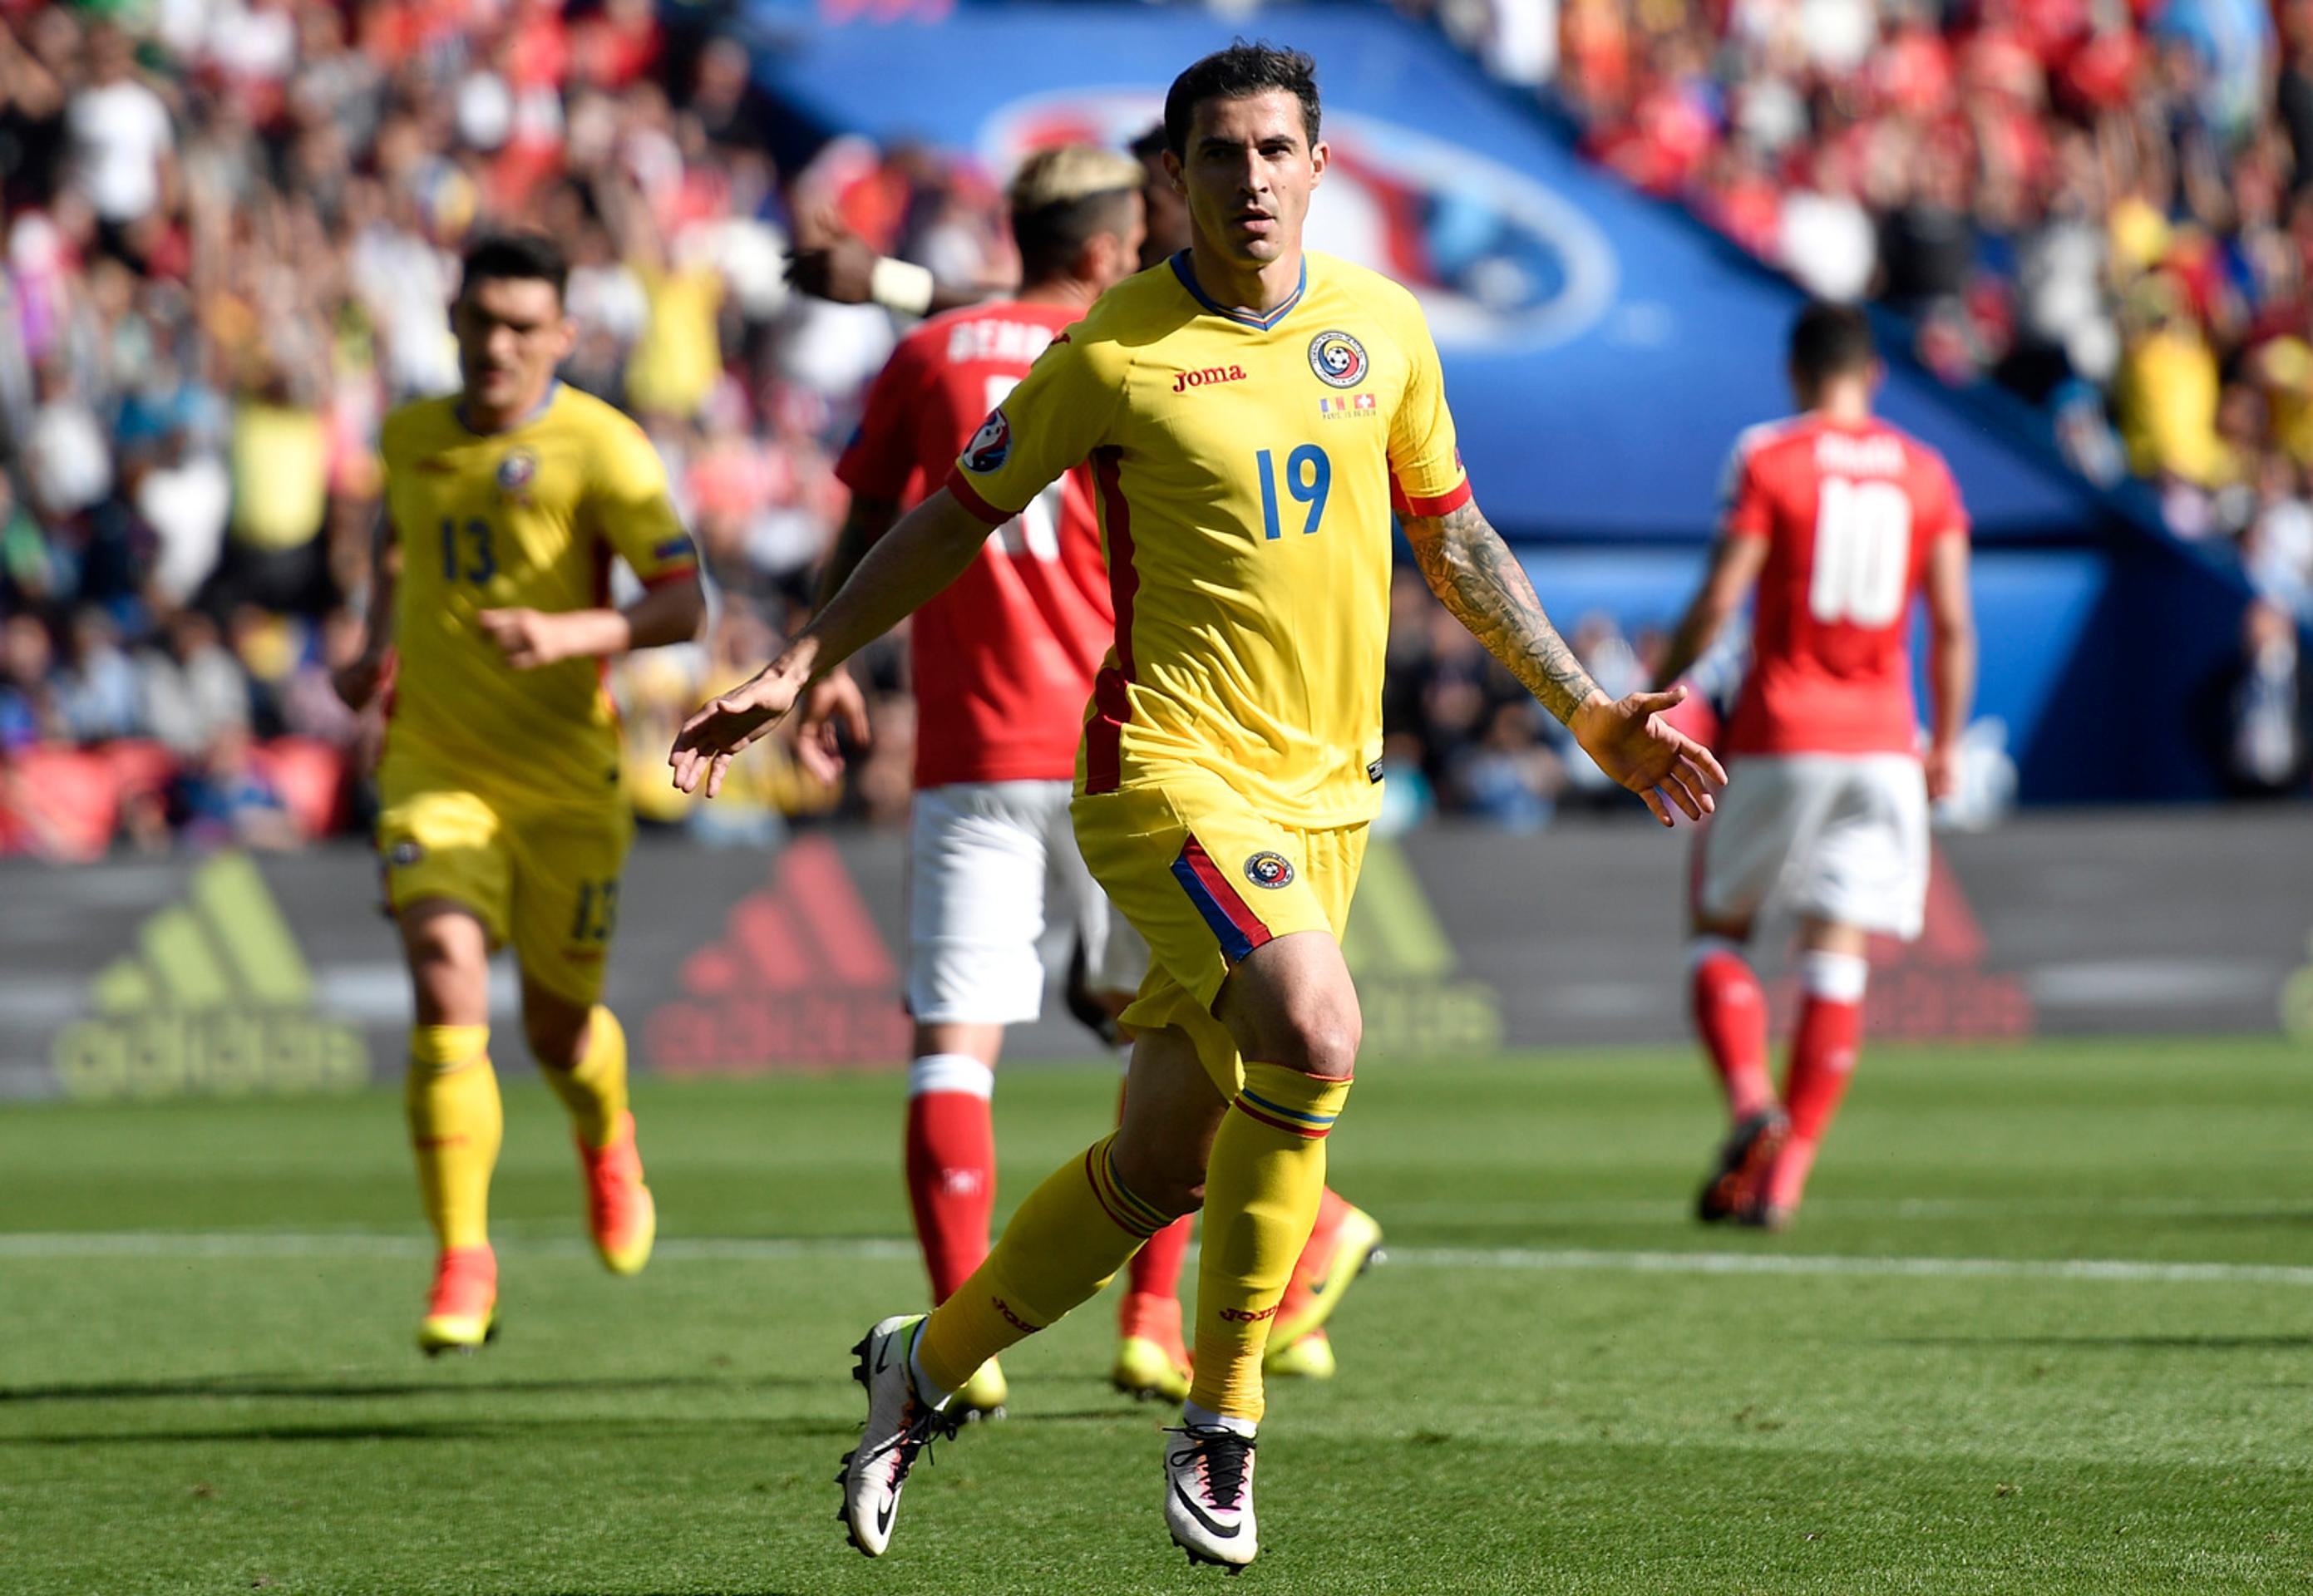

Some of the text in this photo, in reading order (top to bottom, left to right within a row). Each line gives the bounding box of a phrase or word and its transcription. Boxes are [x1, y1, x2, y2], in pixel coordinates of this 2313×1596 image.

[1172, 365, 1246, 393] Joma
[1256, 443, 1331, 540] 19
[443, 518, 496, 584] 13
[1809, 476, 1912, 629] 10
[52, 1006, 371, 1099] adidas
[642, 995, 915, 1072] adida
[991, 1294, 1043, 1334] Jom
[1219, 1305, 1278, 1322] Jom
